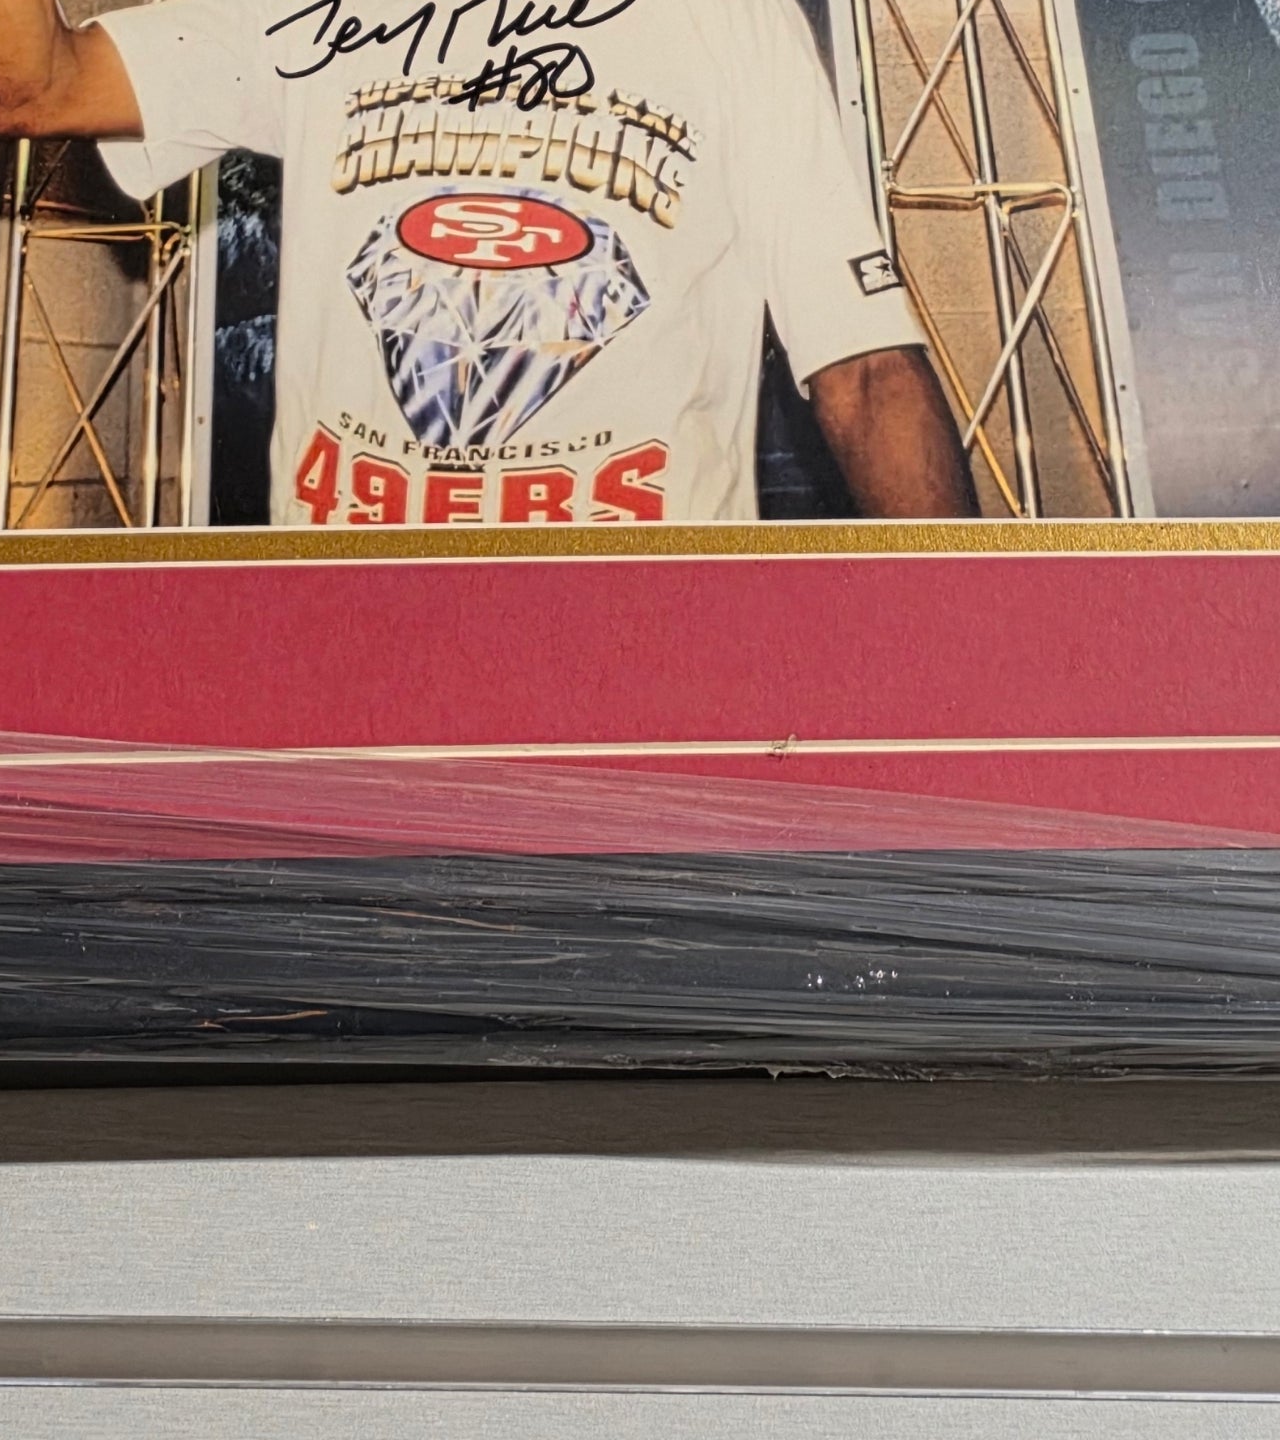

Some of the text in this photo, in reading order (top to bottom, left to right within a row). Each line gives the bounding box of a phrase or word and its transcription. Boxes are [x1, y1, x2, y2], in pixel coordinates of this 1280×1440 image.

[331, 101, 686, 230] CHAMPIONS
[1129, 33, 1230, 220] DIEGO
[295, 420, 671, 524] 49ERS
[338, 411, 613, 462] SAN FRANCISCO
